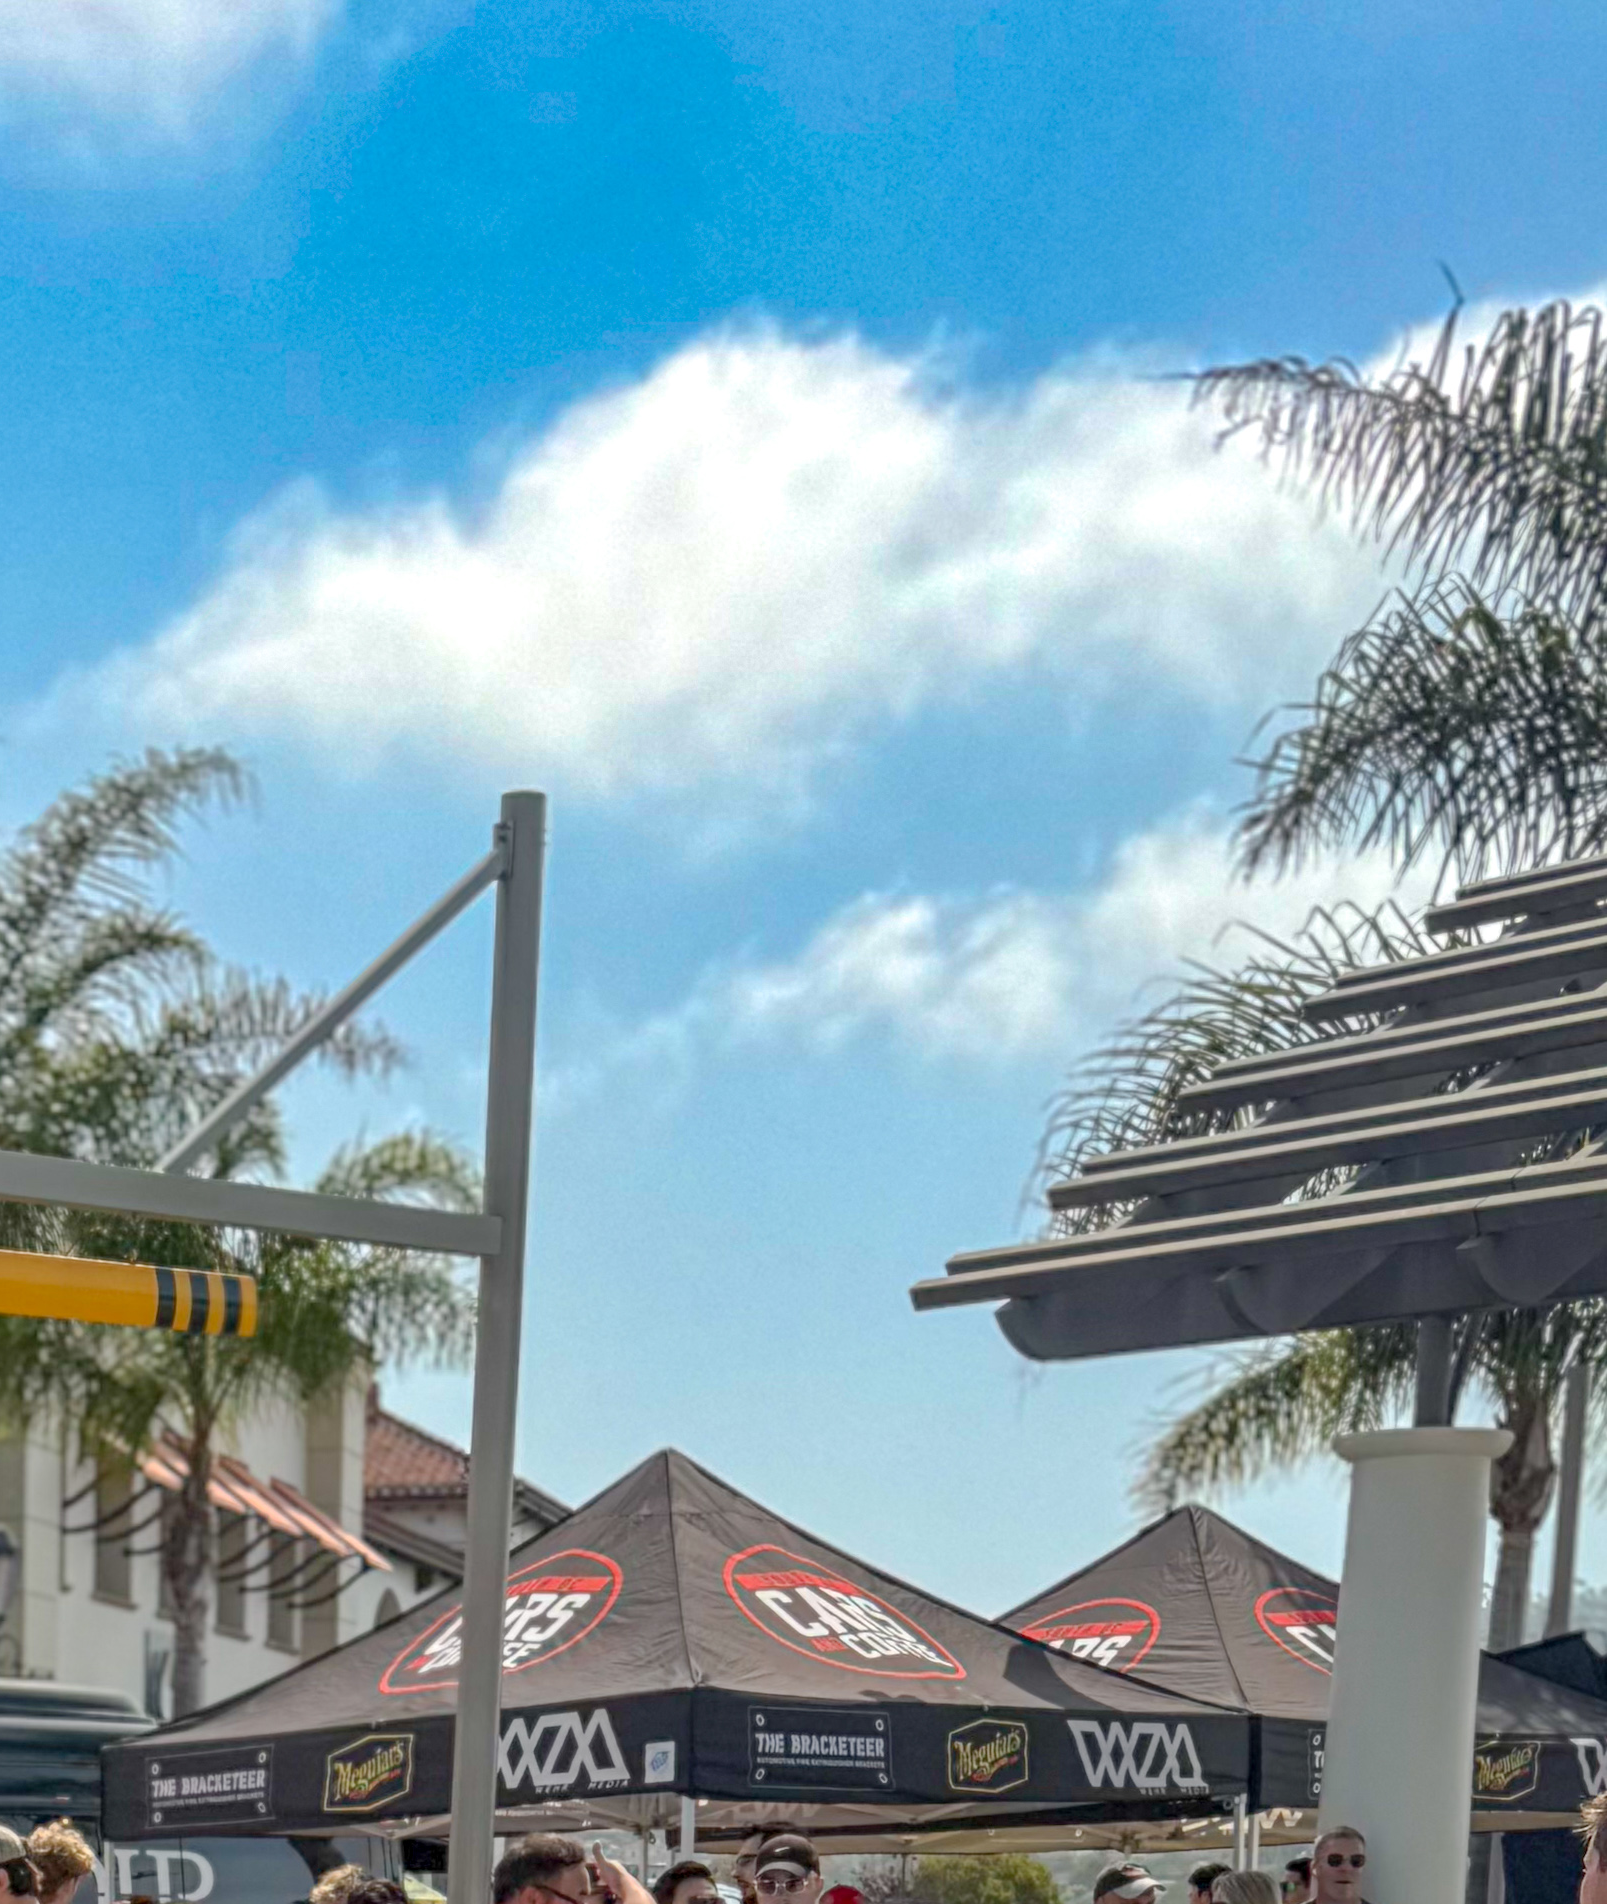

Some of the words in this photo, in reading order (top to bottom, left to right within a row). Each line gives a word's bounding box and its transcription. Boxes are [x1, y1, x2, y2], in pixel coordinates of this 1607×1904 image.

[754, 1586, 918, 1645] CARS
[754, 1732, 785, 1754] THE
[790, 1734, 885, 1758] BRACKETEER
[151, 1778, 177, 1798] THE
[182, 1769, 266, 1796] BRACKETEER
